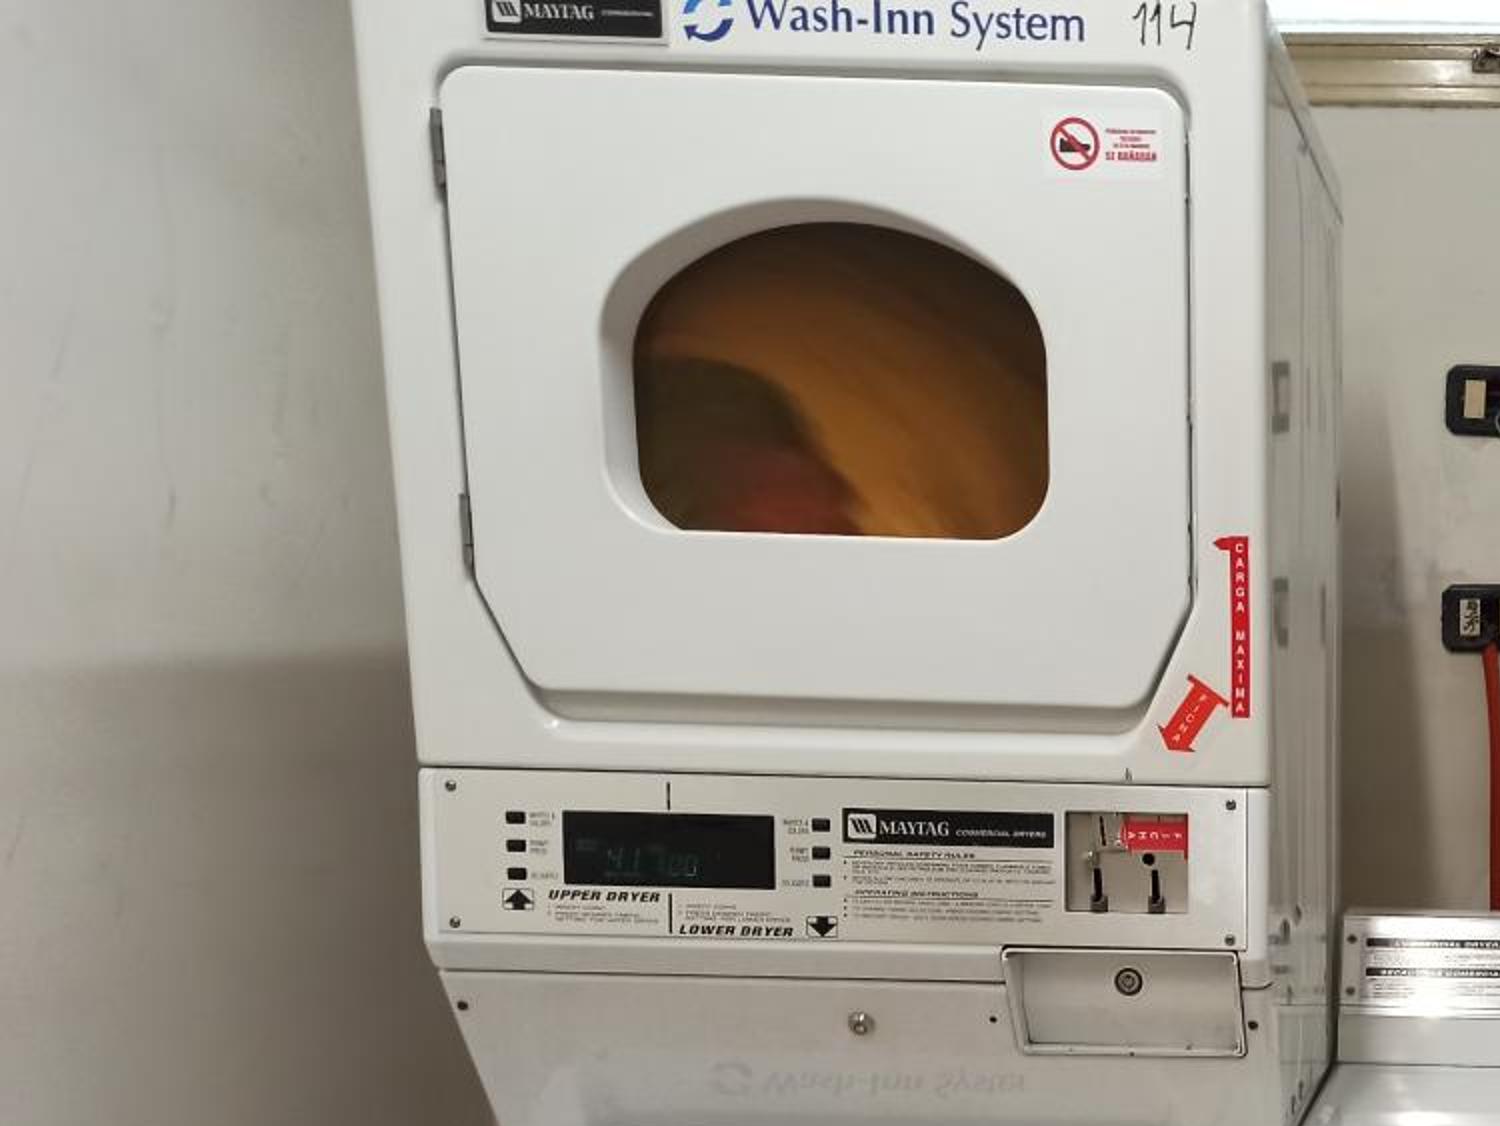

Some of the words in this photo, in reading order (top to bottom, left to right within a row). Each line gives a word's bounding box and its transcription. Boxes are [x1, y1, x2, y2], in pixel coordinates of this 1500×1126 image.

[524, 3, 595, 20] MAYTAG
[746, 0, 935, 34] Wash-Inn
[950, 1, 1086, 51] System
[1133, 2, 1196, 50] 114
[1235, 543, 1246, 612] CARGA
[1235, 631, 1247, 713] MAXIMA
[1172, 693, 1208, 743] FICHA
[879, 819, 949, 837] MAYTAG
[548, 890, 601, 901] UPPER
[606, 891, 660, 903] DRYER
[680, 924, 736, 935] LOWER
[740, 926, 794, 937] DRYER
